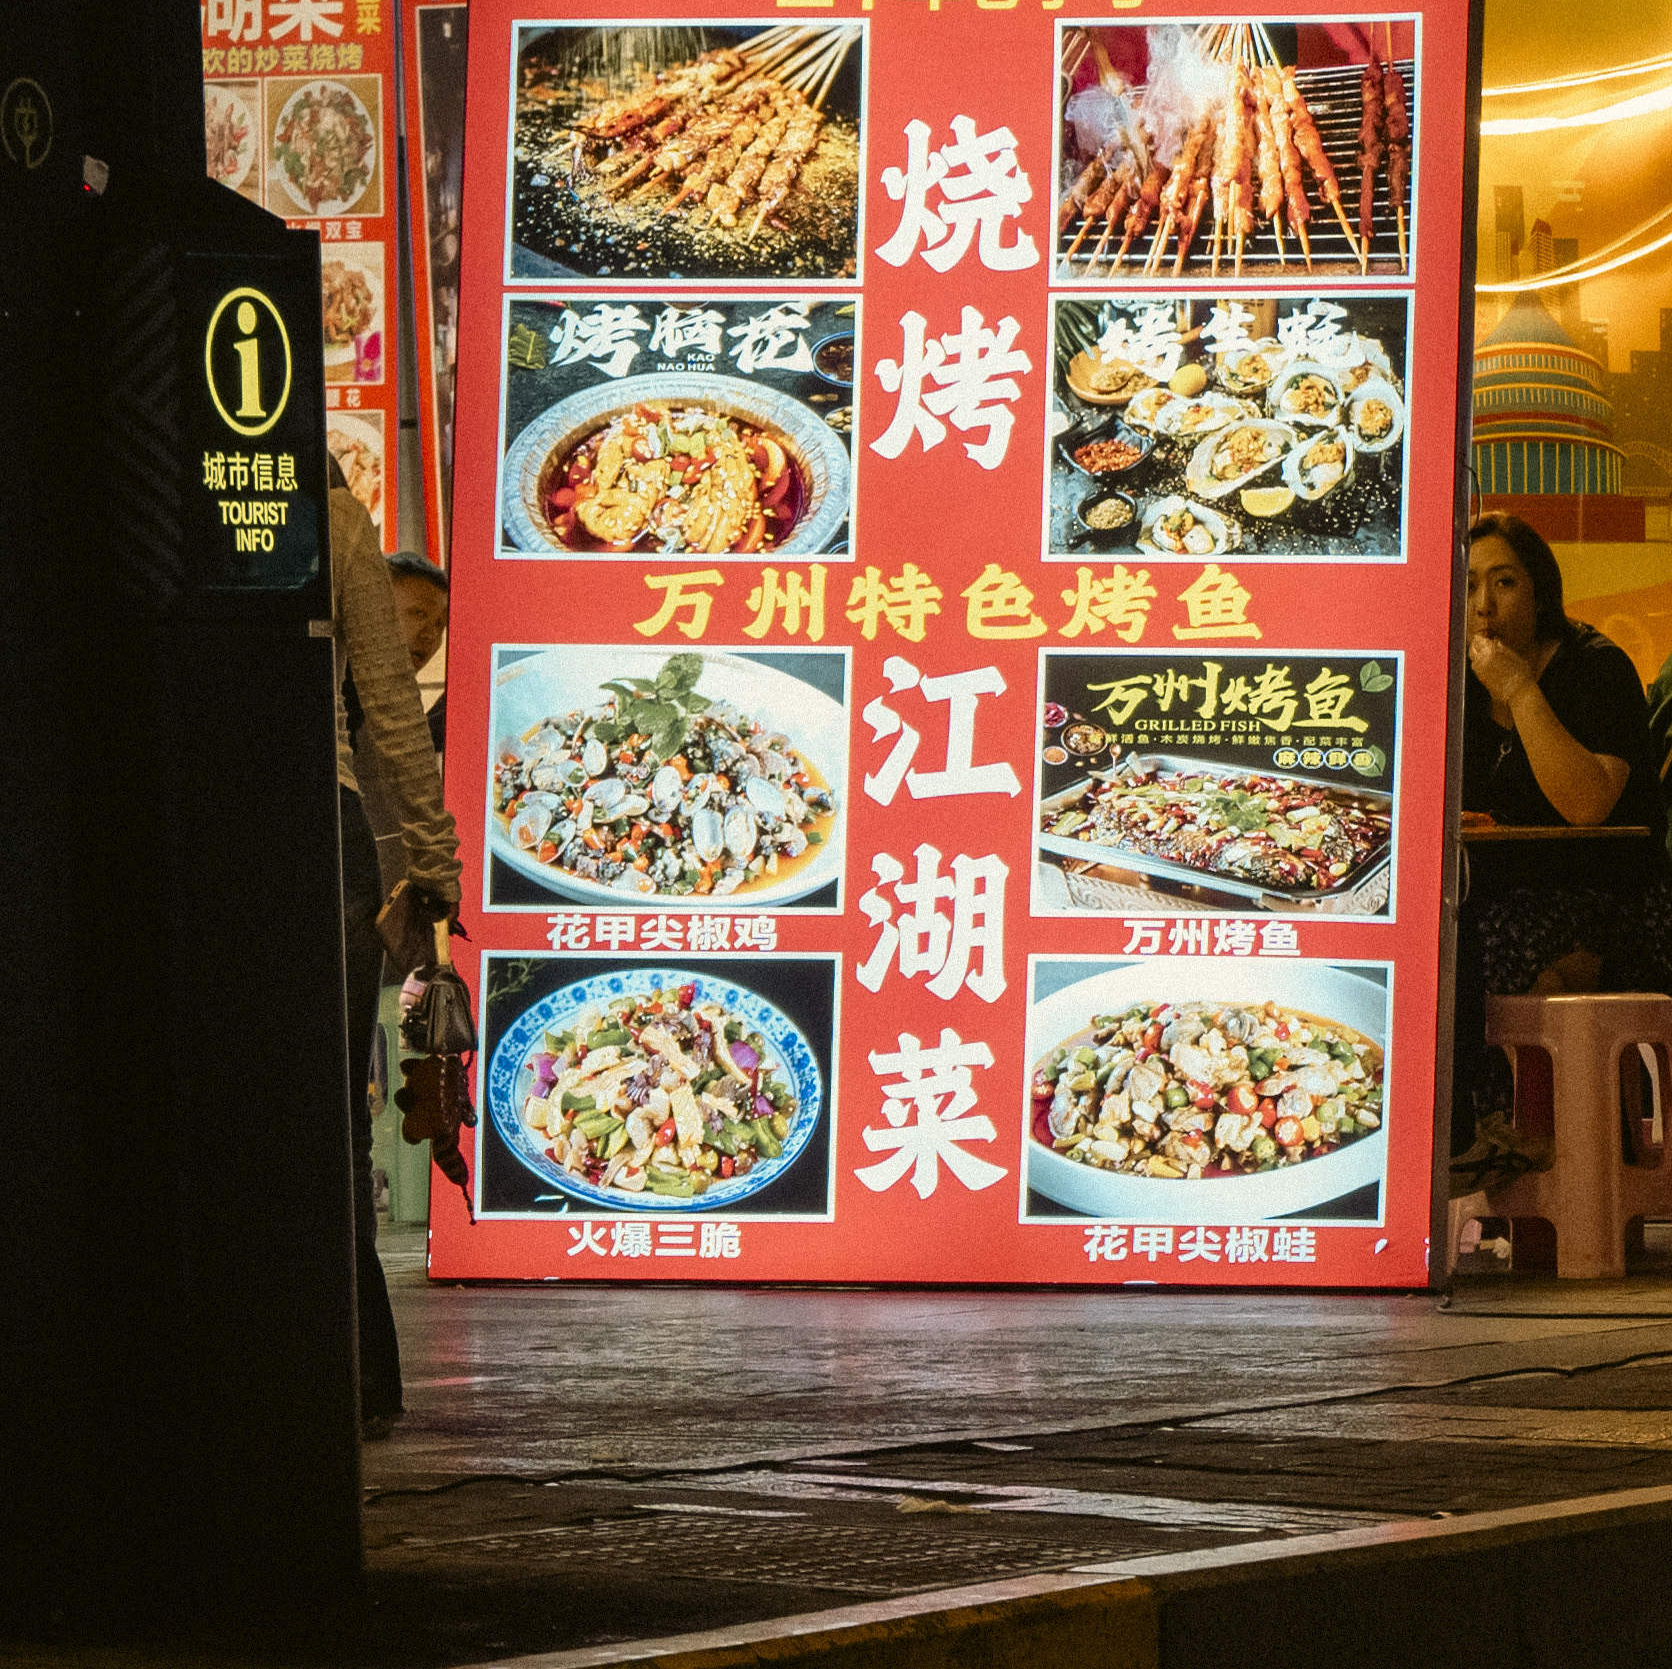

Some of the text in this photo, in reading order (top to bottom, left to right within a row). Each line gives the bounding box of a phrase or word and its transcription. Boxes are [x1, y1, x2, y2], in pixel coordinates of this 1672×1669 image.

[869, 114, 1040, 470] 烧烤
[687, 353, 715, 363] KAO
[1097, 302, 1366, 382] 烤生蚝
[656, 363, 715, 372] NAO HUA
[202, 451, 299, 492] 城市信息
[218, 500, 289, 525] TOURIST
[235, 528, 275, 552] INFO
[633, 562, 1263, 643] 万州特色烤鱼
[1086, 661, 1369, 733] 万州烤鱼
[1134, 718, 1262, 732] GRILLED FISH
[545, 913, 778, 951] 花甲尖椒鸡
[855, 655, 1022, 1200] 江湖菜
[1122, 919, 1301, 957] 万州烤鱼
[566, 1221, 742, 1260] 火爆三脆
[1083, 1225, 1317, 1264] 花甲尖椒蛙
